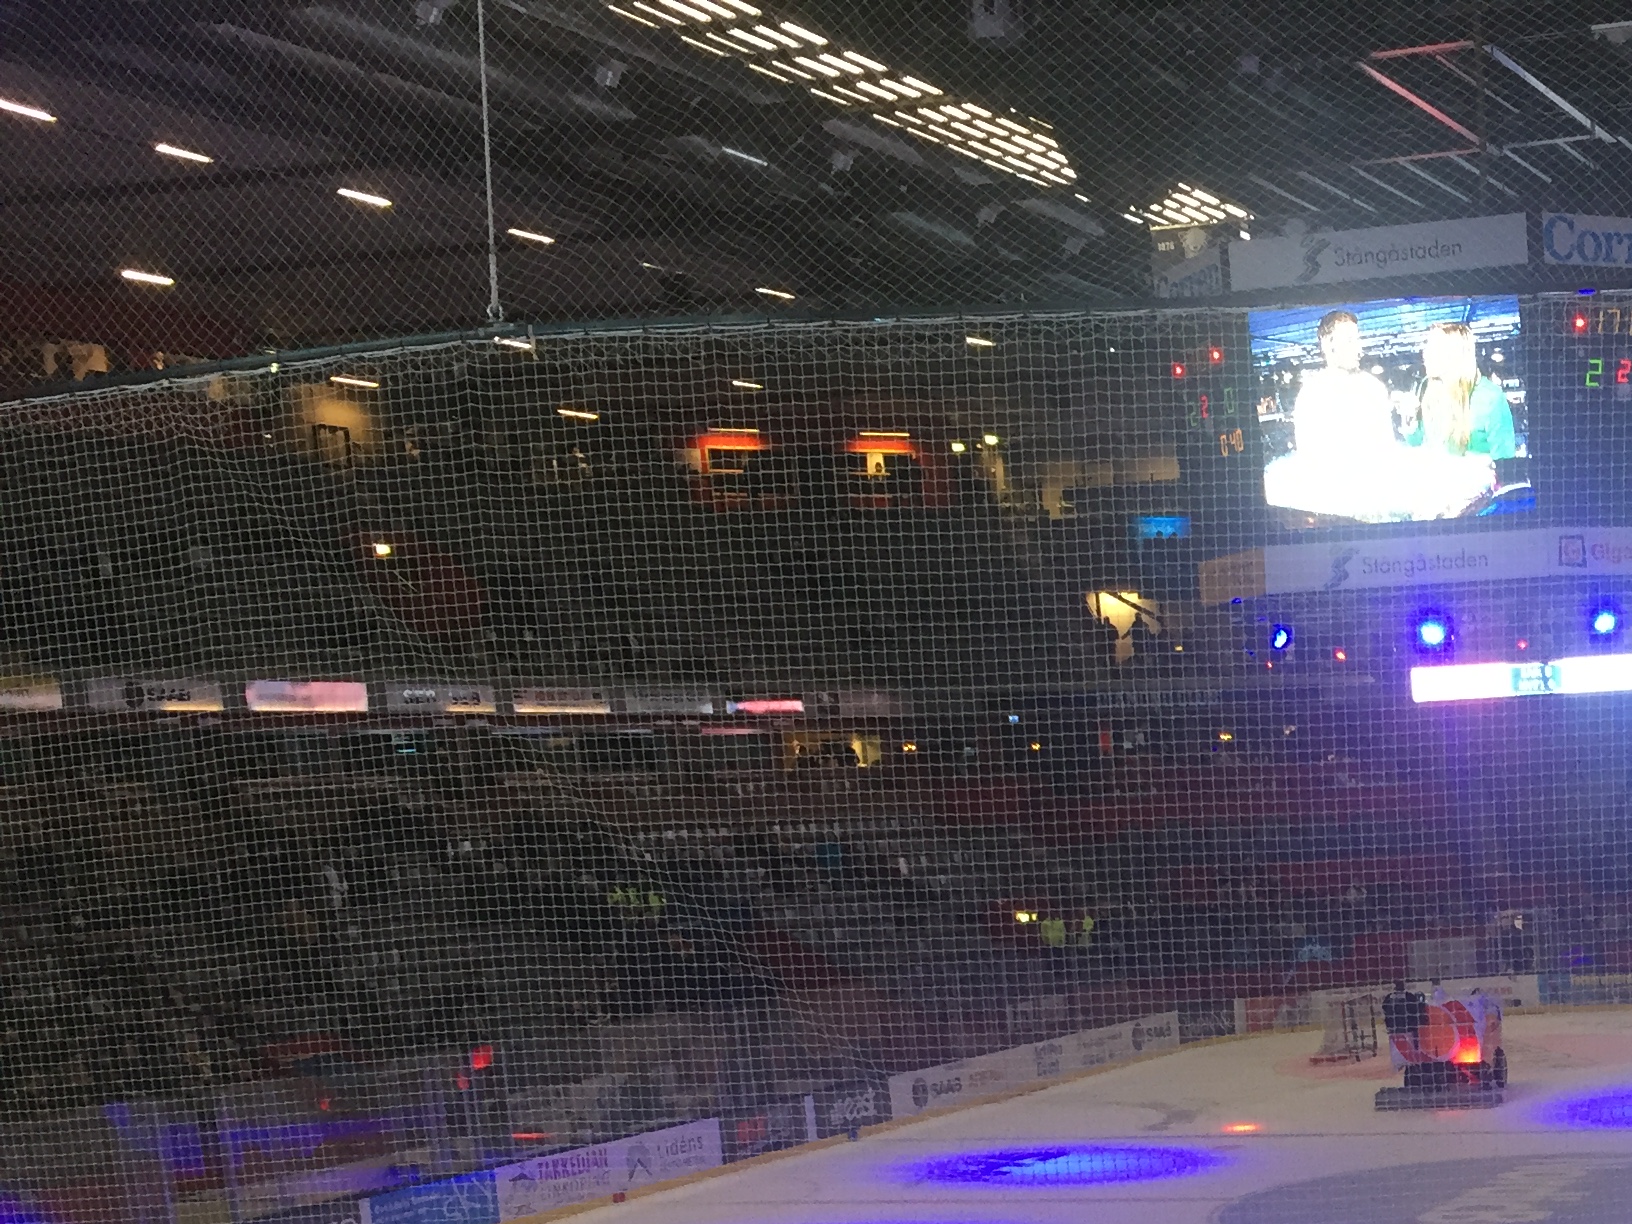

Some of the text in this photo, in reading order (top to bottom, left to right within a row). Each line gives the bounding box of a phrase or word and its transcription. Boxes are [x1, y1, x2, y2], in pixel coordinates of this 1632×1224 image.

[1334, 239, 1463, 269] Stångåstaden
[1585, 358, 1603, 387] 2
[1616, 357, 1632, 384] 2
[1362, 541, 1489, 575] Stångåstaden
